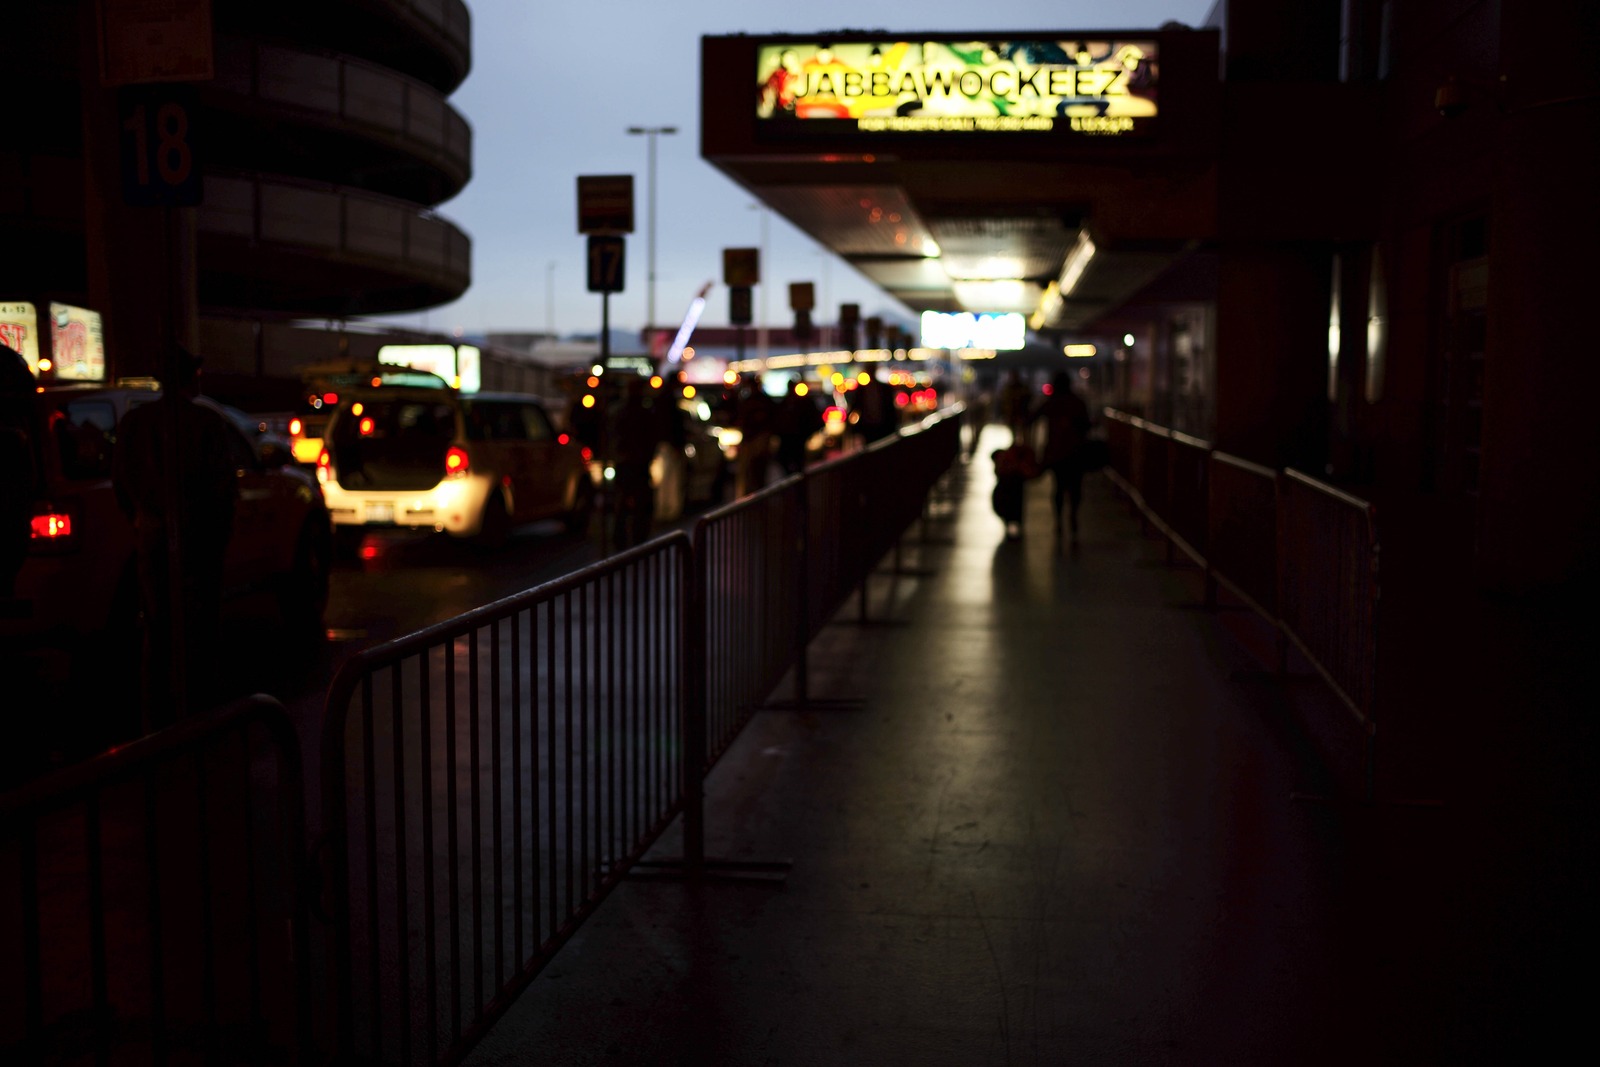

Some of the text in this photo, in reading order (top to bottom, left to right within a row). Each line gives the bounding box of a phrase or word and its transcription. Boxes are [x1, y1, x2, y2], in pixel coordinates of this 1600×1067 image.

[796, 70, 1123, 98] JABBAWOCKEEZ
[122, 101, 193, 186] 18
[590, 240, 621, 286] 17
